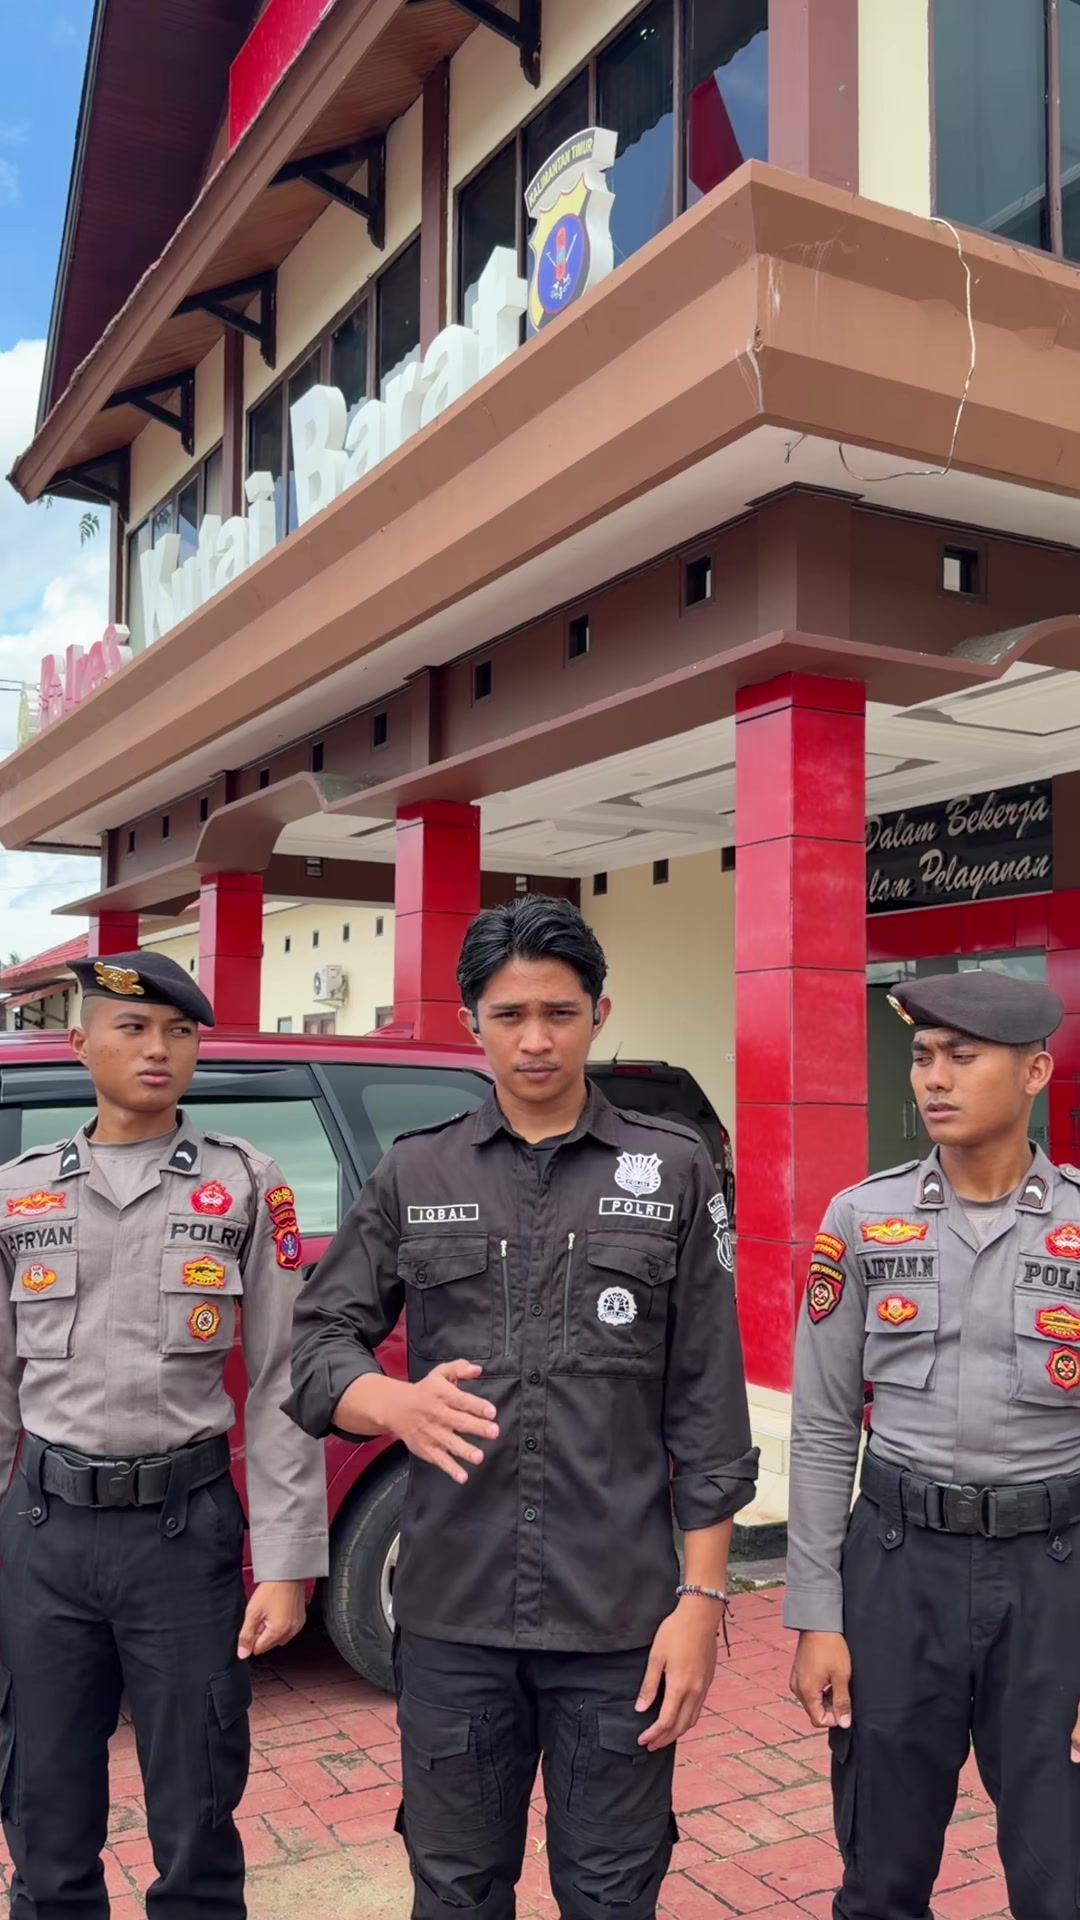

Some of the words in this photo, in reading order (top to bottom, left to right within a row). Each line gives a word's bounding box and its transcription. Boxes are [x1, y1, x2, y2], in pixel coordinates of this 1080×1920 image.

[527, 149, 571, 207] KALIMANTAN
[570, 137, 593, 160] TIMUR
[140, 471, 276, 648] Kutai
[290, 246, 528, 527] Barat
[866, 812, 936, 853] Dalam
[945, 785, 1049, 839] Bekerja
[868, 869, 912, 903] lam
[919, 848, 1050, 899] Pelayanan
[419, 1207, 467, 1220] IQBAL
[612, 1200, 661, 1217] POLRI
[8, 1226, 73, 1253] AFRYAN
[170, 1223, 242, 1247] POLRI
[1023, 1261, 1080, 1292] POL
